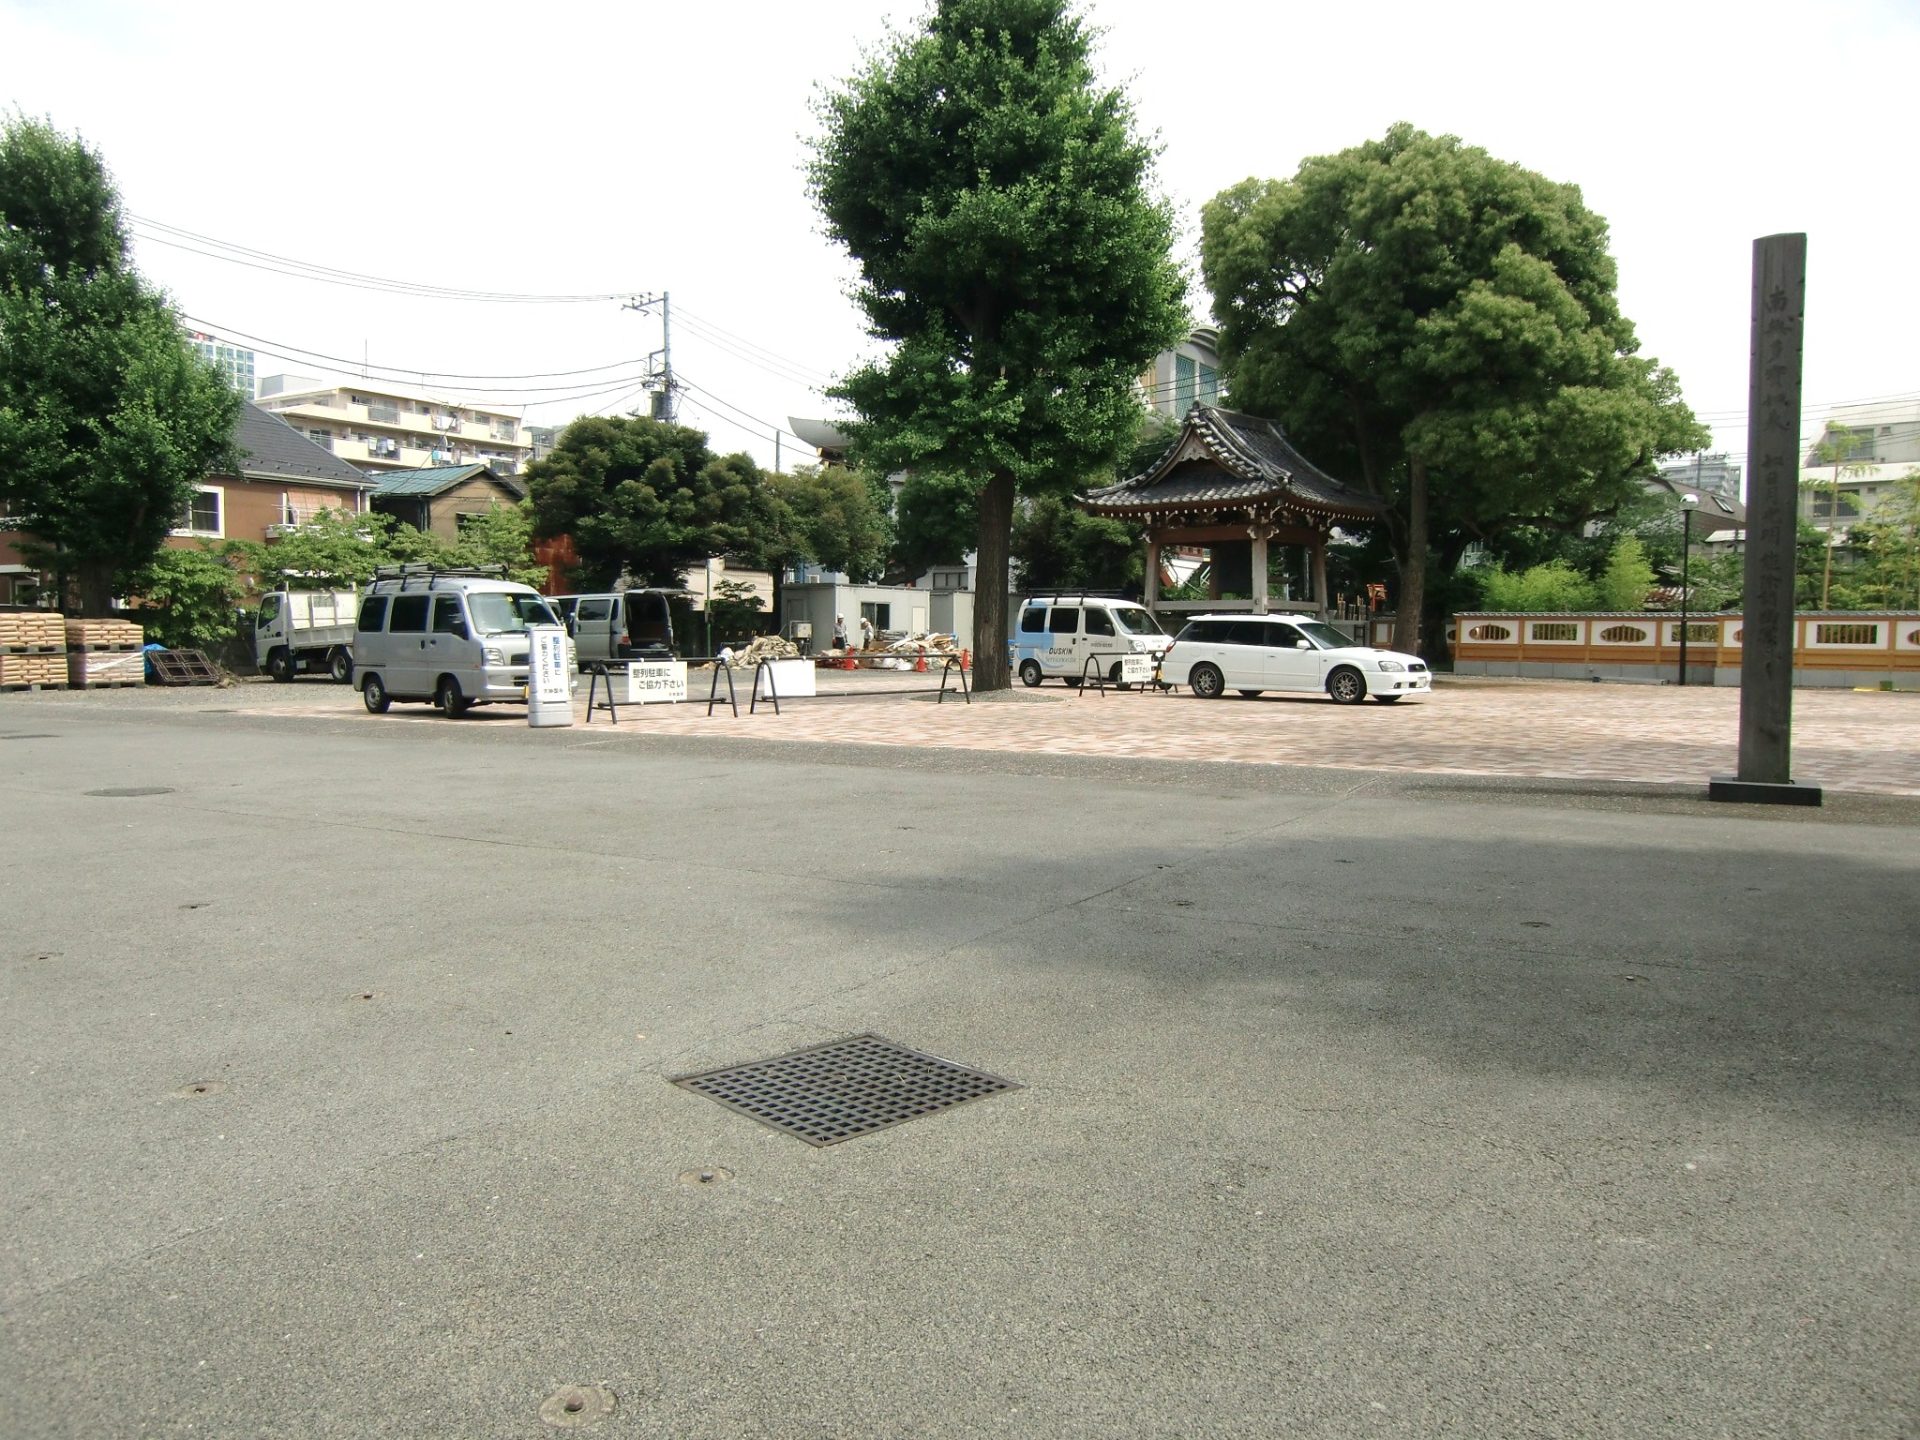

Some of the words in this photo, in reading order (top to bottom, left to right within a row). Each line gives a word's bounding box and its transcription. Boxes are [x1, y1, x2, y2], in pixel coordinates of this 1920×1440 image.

[1048, 647, 1074, 655] DUSKIN
[633, 668, 671, 678] 整列駐車に
[638, 679, 685, 690] ご協力下さい
